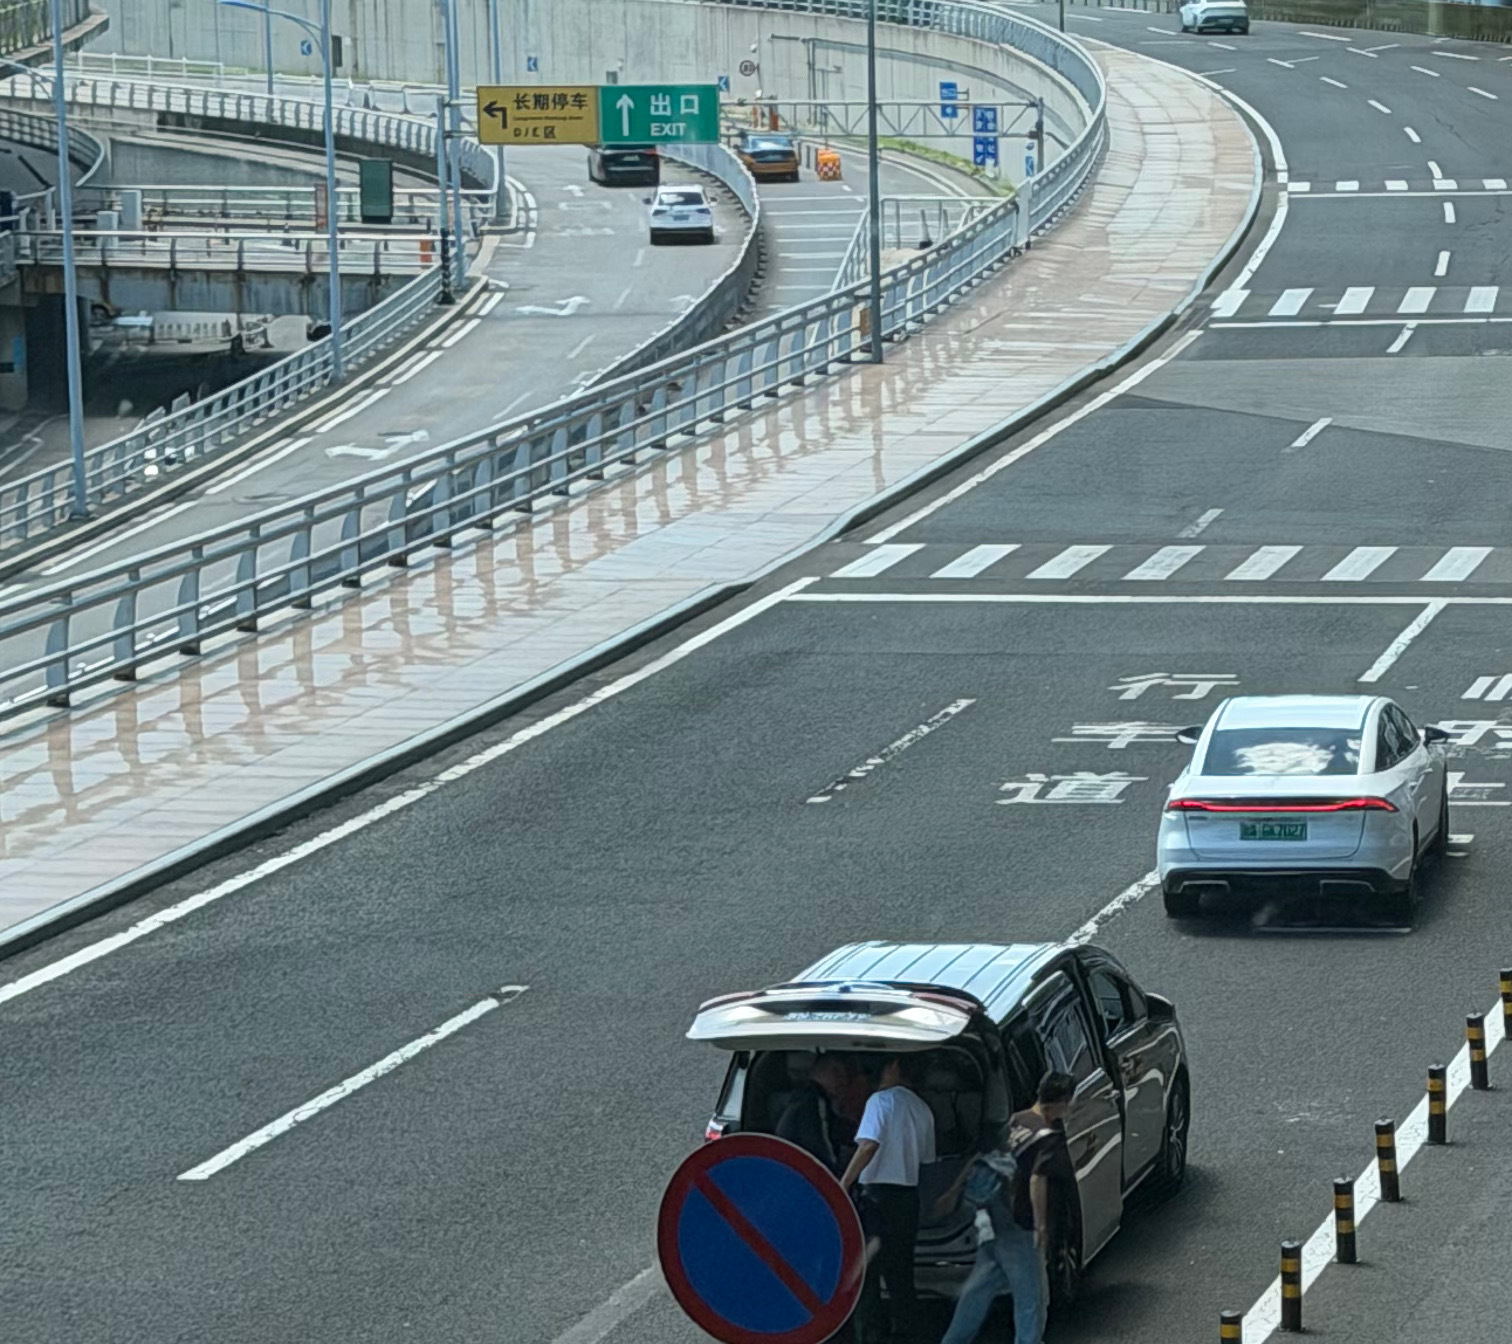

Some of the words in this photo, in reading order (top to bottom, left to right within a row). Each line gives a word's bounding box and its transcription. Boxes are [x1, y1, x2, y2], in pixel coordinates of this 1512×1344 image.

[513, 92, 589, 111] 长期停车
[650, 92, 699, 117] 出口
[650, 123, 686, 137] EXIT
